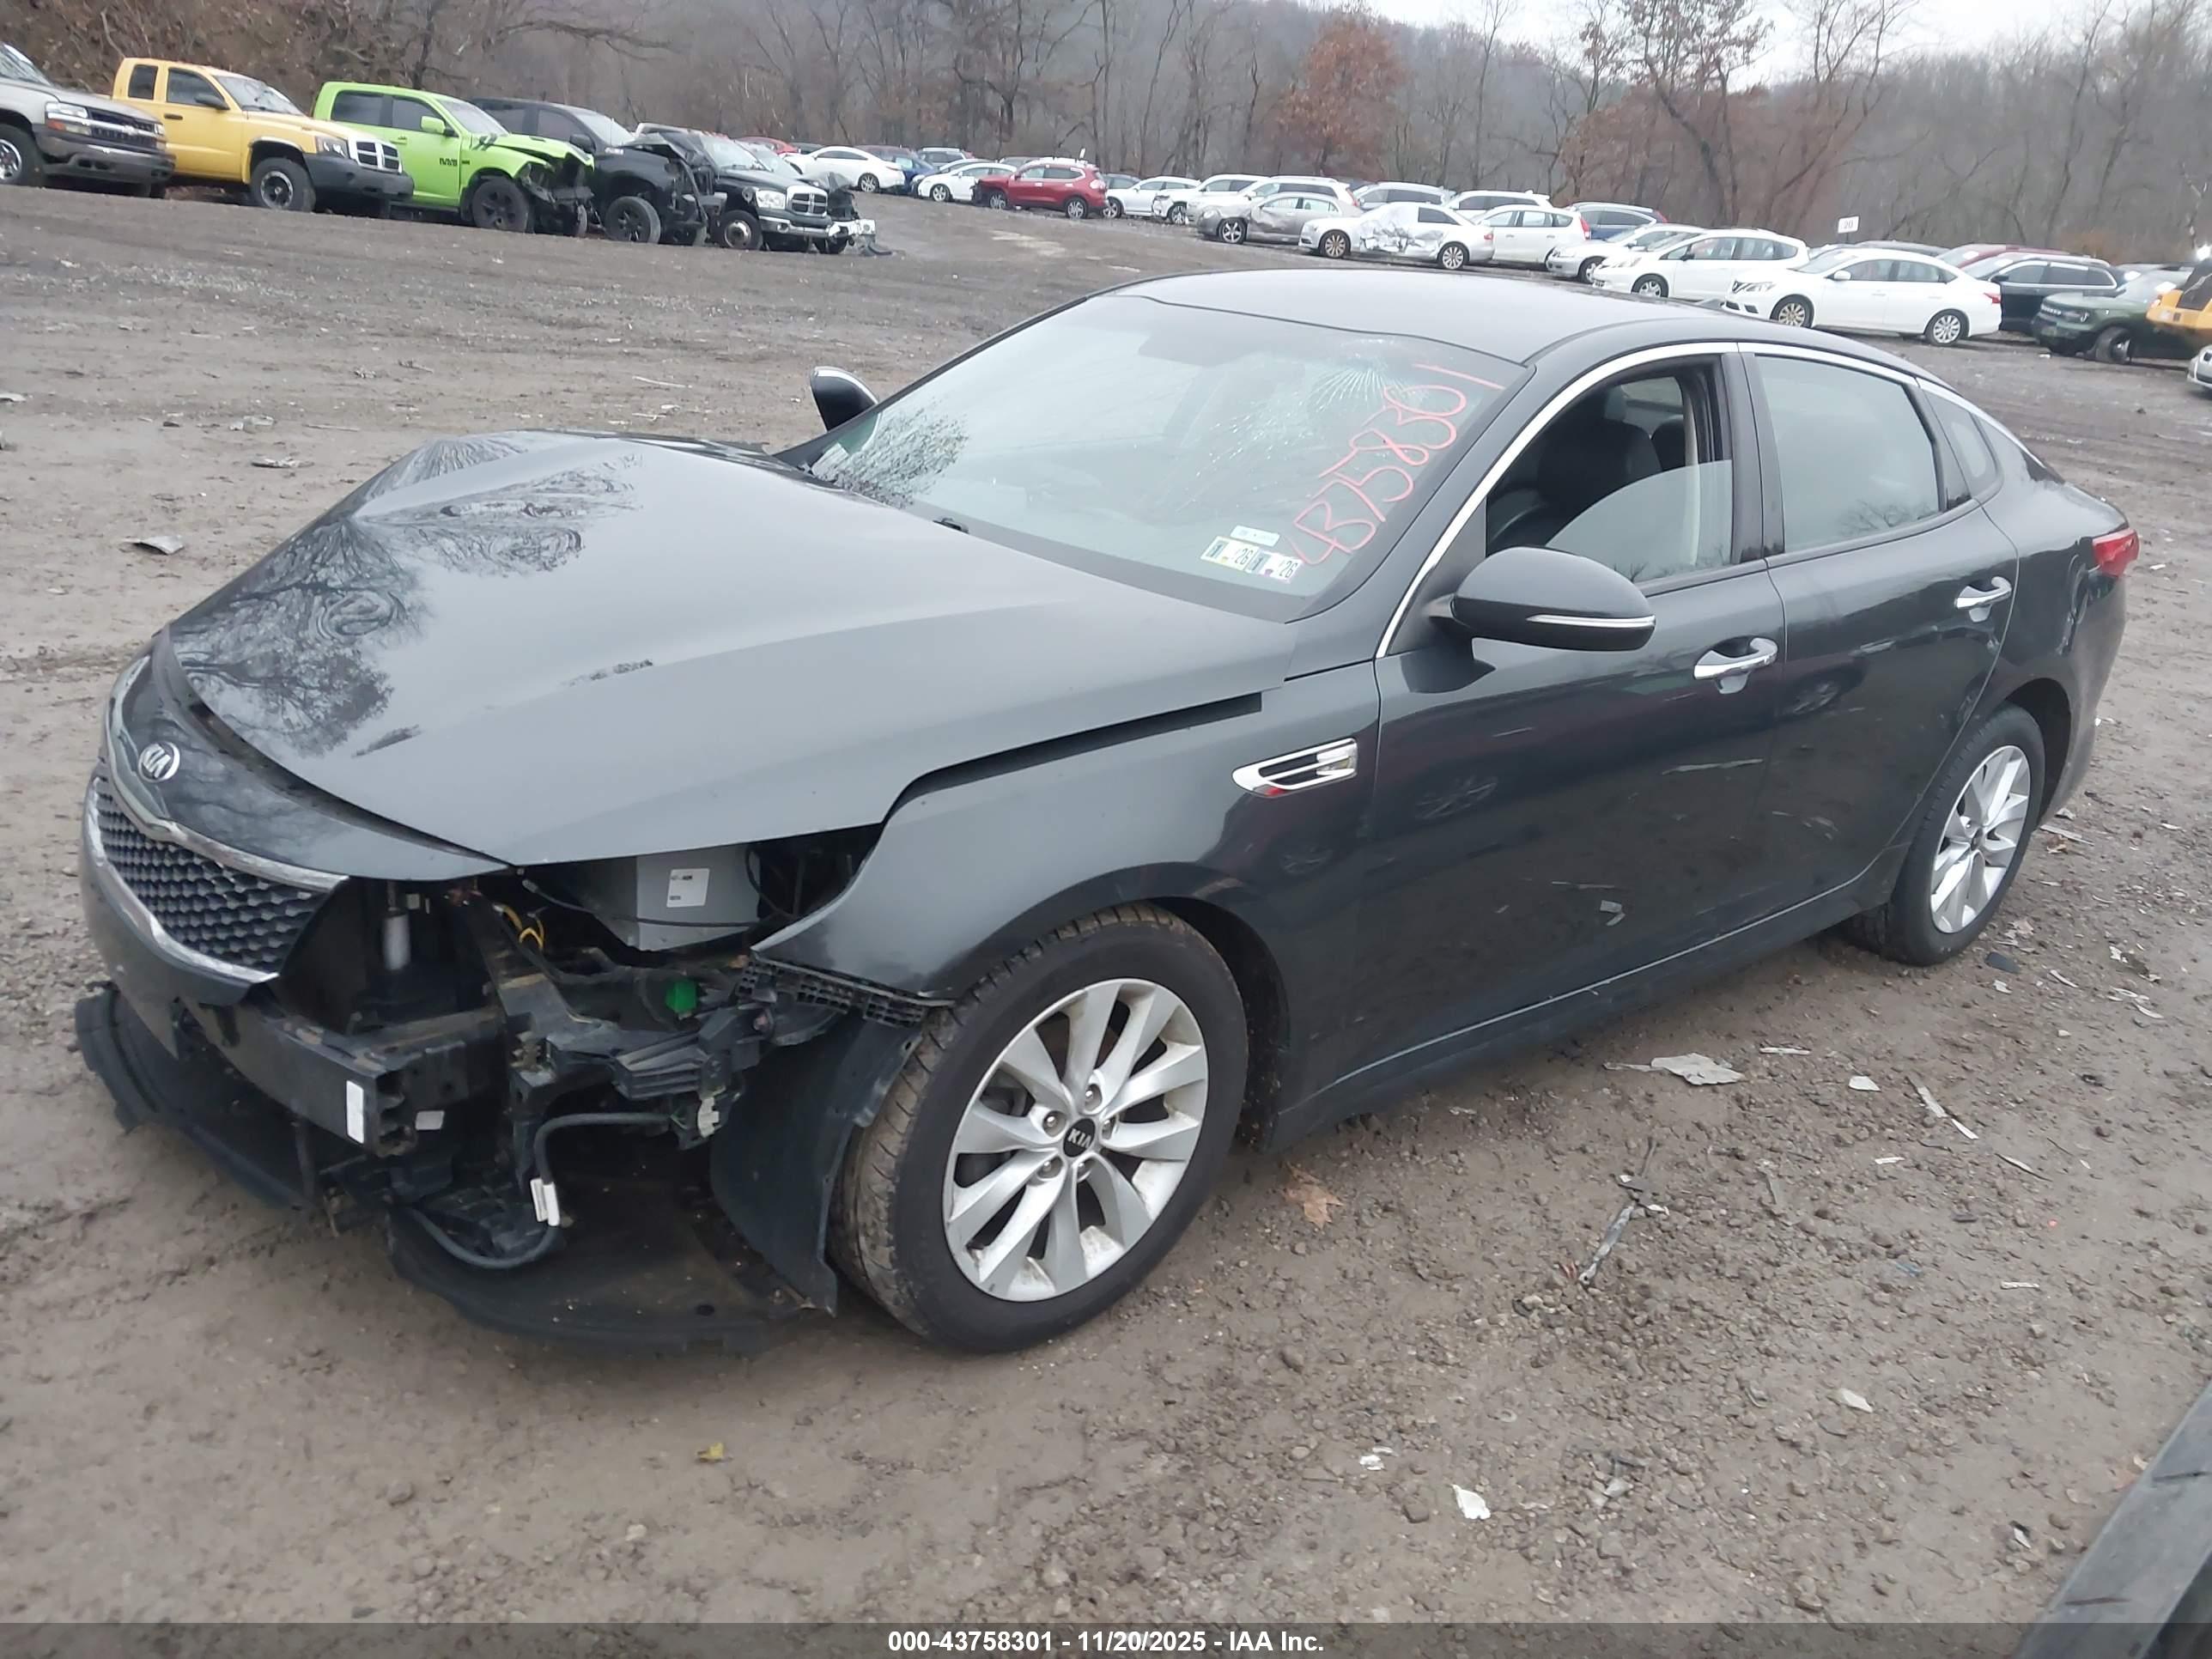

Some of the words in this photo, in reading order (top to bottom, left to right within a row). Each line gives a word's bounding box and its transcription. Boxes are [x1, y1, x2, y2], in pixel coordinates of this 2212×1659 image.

[1287, 363, 1505, 565] 43758301
[1235, 548, 1254, 565] 26
[1279, 560, 1298, 578] 26
